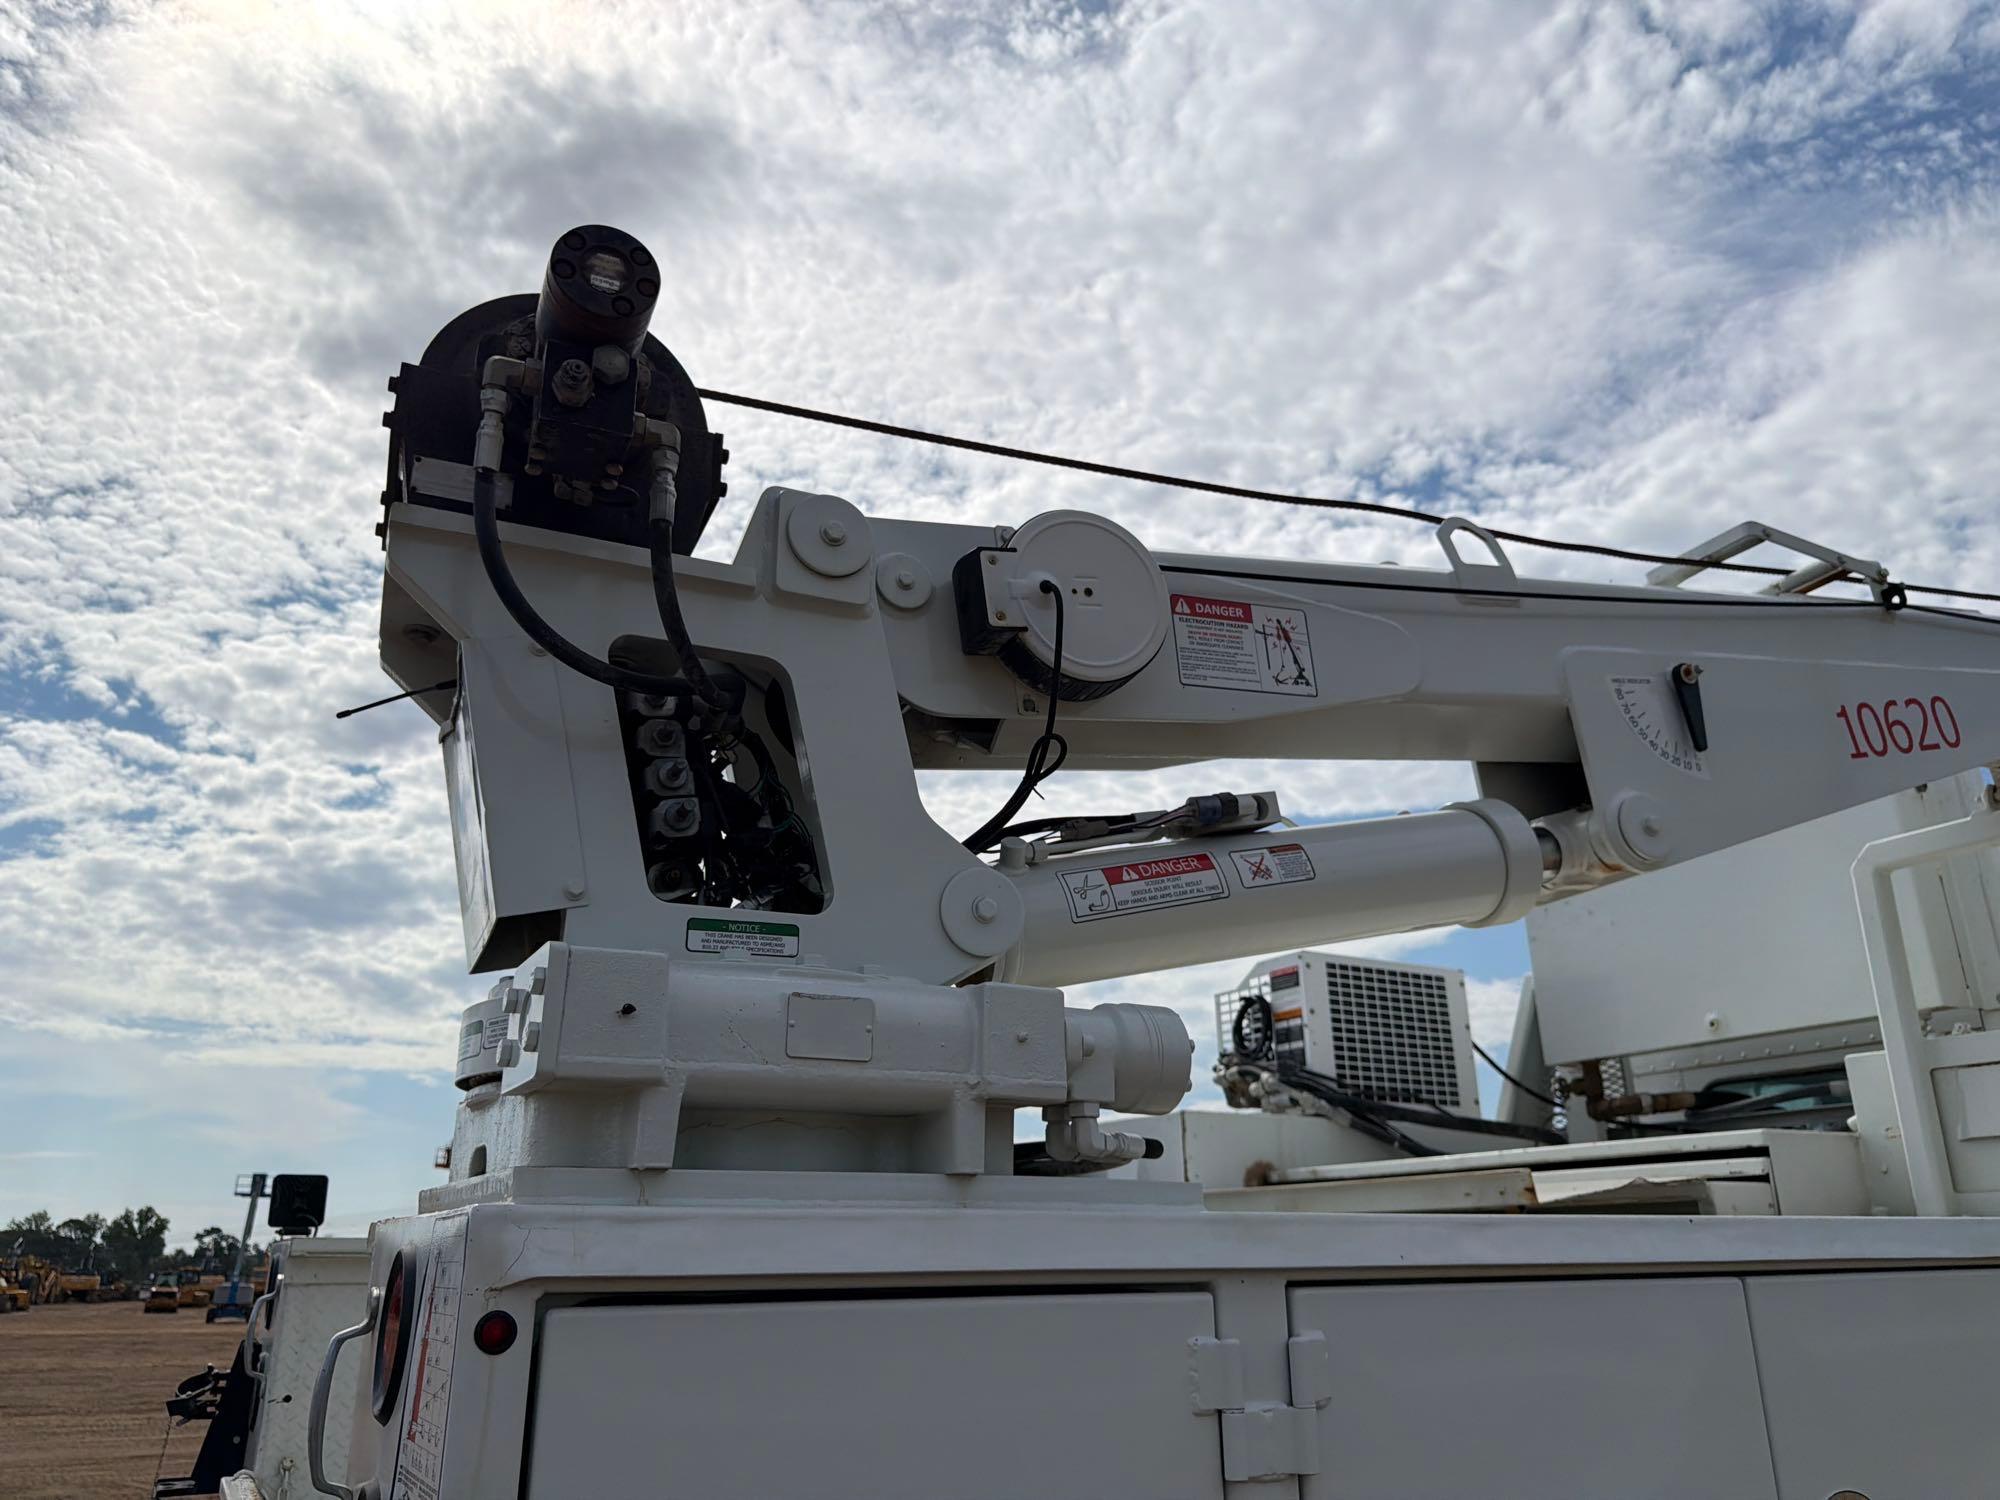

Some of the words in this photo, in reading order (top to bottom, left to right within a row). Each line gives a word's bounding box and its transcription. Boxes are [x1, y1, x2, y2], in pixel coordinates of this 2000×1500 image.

[1195, 603, 1244, 617] DANGER
[1179, 617, 1224, 627] ELECTROCUTION
[1621, 702, 1630, 714] 70
[1628, 716, 1638, 728] 60
[1836, 696, 1961, 759] 10620
[1638, 728, 1648, 740] 50
[1649, 740, 1658, 751] 40
[1660, 748, 1669, 760] 30
[1672, 755, 1681, 766] 20
[1684, 760, 1692, 770] 10
[1696, 763, 1702, 771] 0
[1139, 857, 1202, 876] DANGER
[1131, 888, 1153, 896] SERIOUS
[1130, 896, 1148, 904] HANDS
[728, 923, 760, 932] NOTICE
